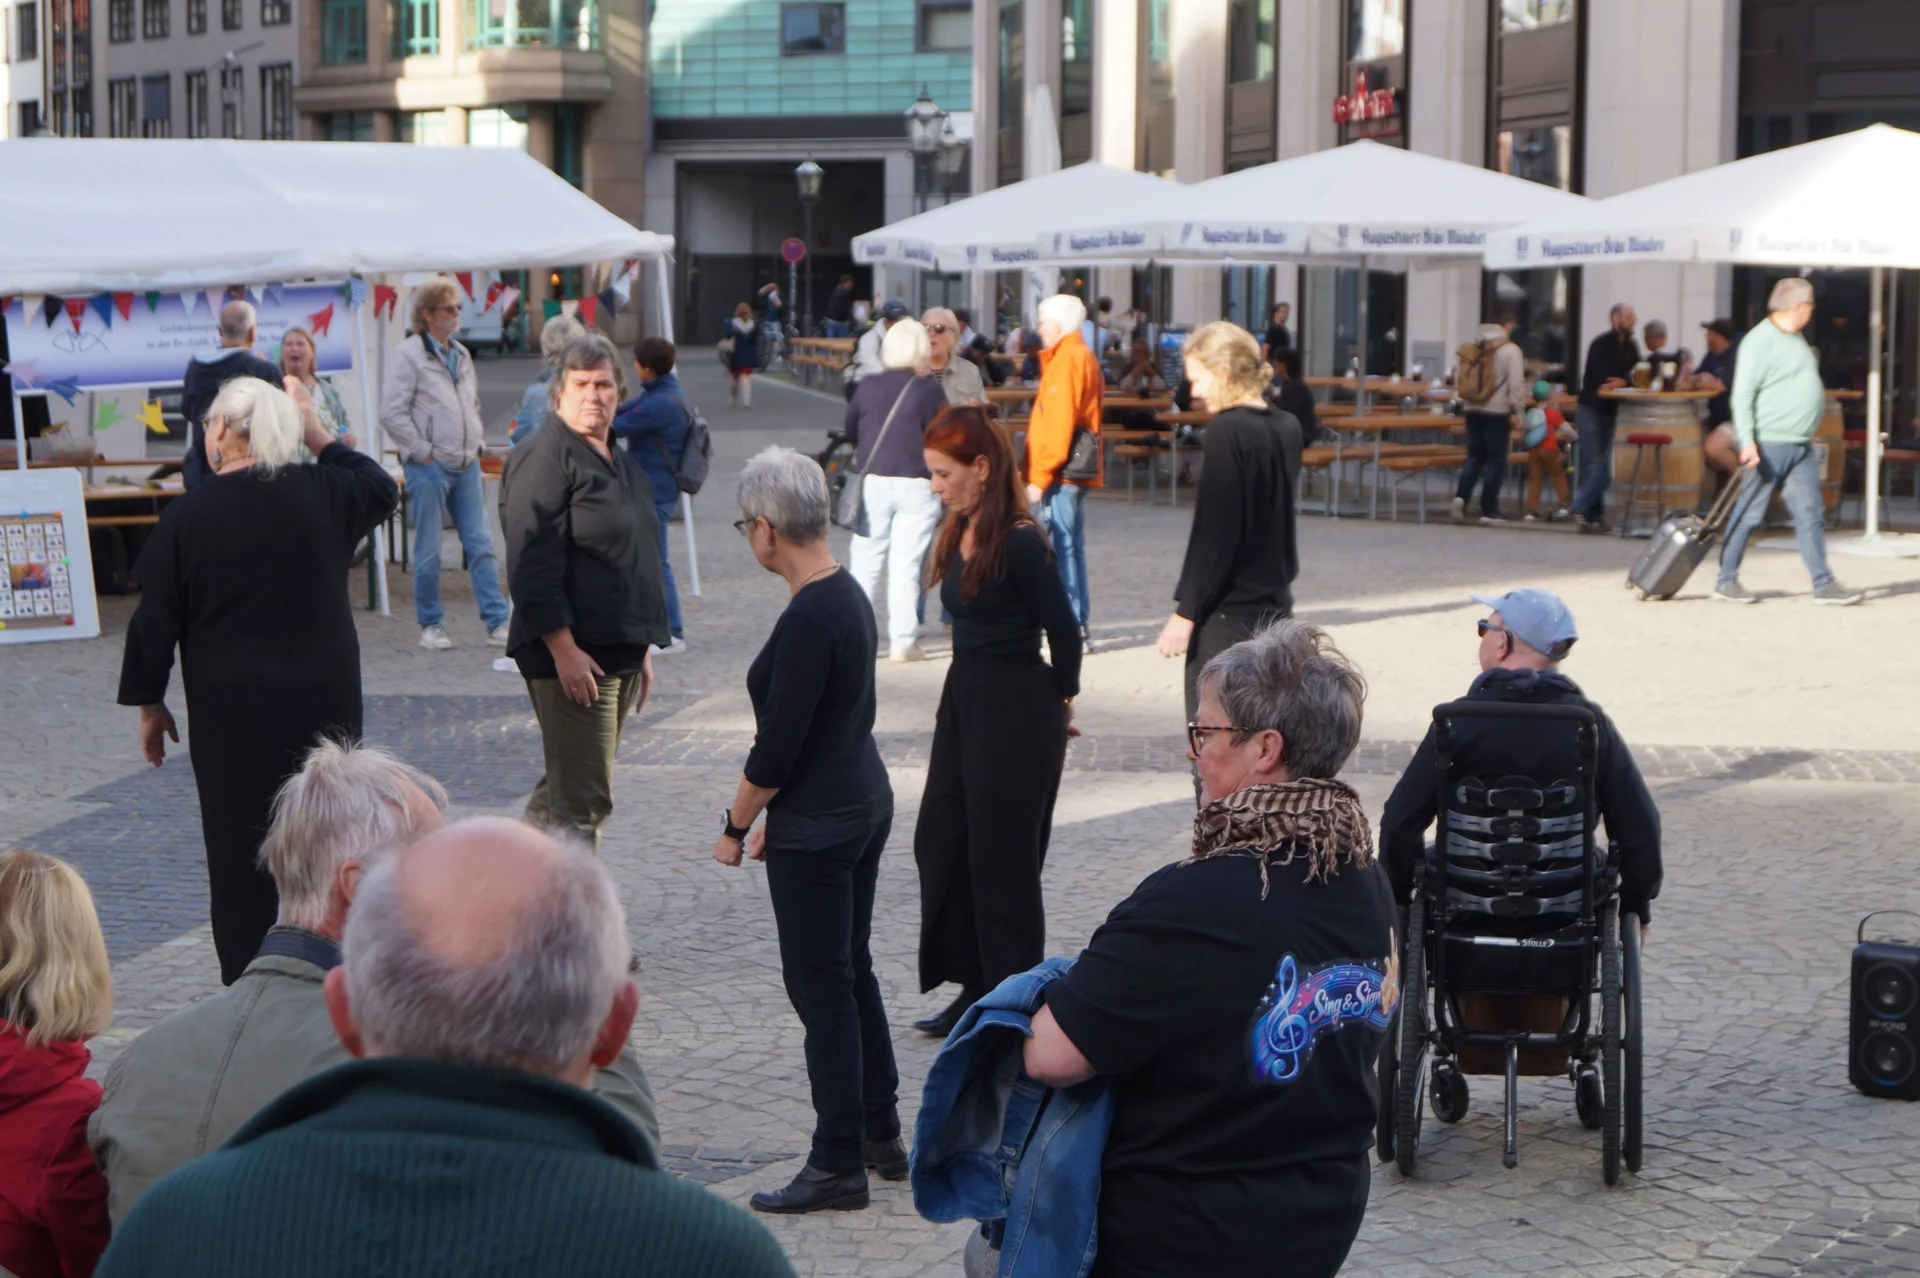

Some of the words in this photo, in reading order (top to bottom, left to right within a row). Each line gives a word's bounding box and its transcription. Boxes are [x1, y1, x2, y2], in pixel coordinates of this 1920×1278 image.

[1310, 989, 1342, 1022] Sing
[1343, 993, 1353, 1011] &
[1351, 980, 1382, 1016] Sign
[1869, 1019, 1907, 1031] W-KING
